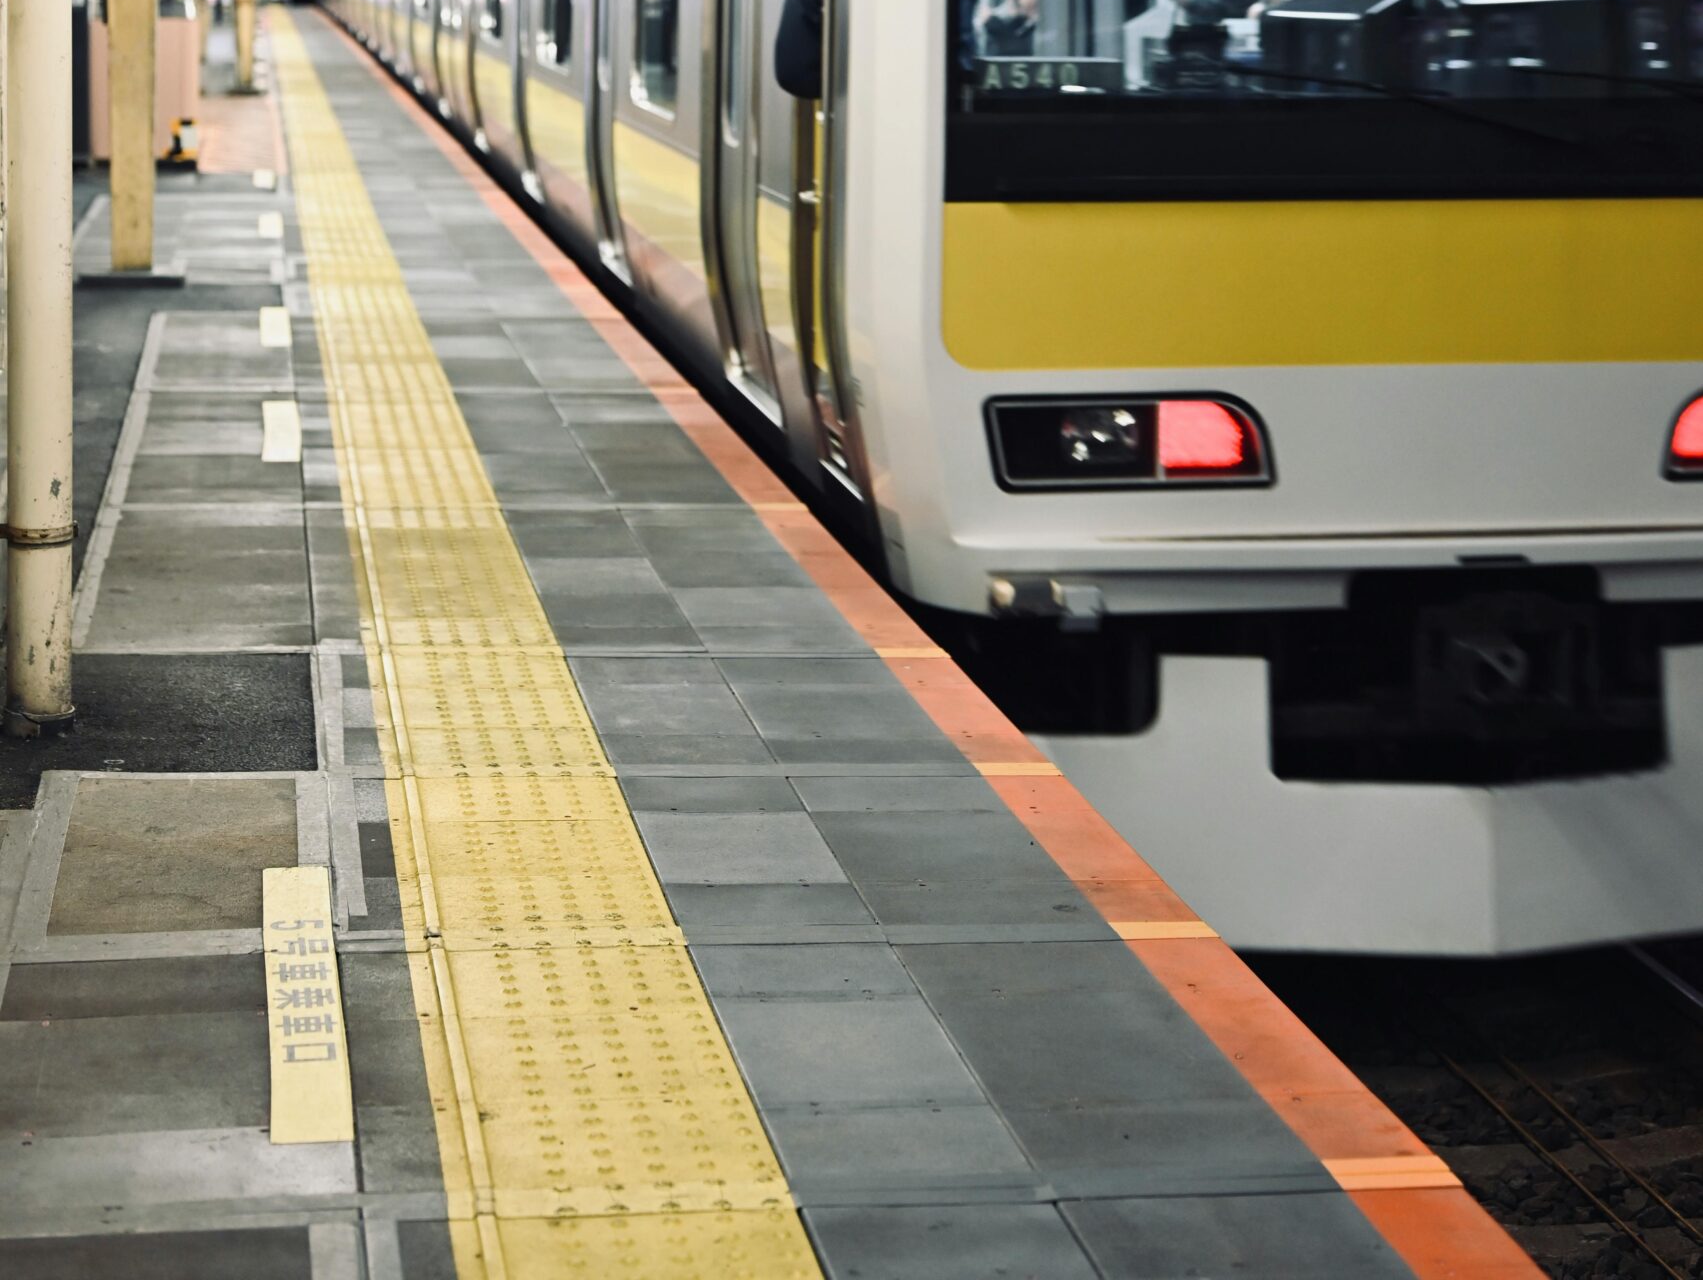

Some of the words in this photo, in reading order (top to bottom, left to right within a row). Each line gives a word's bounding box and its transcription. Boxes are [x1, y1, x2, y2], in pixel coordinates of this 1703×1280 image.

[983, 62, 1080, 90] A540
[270, 919, 338, 1063] 5号車乗車口
